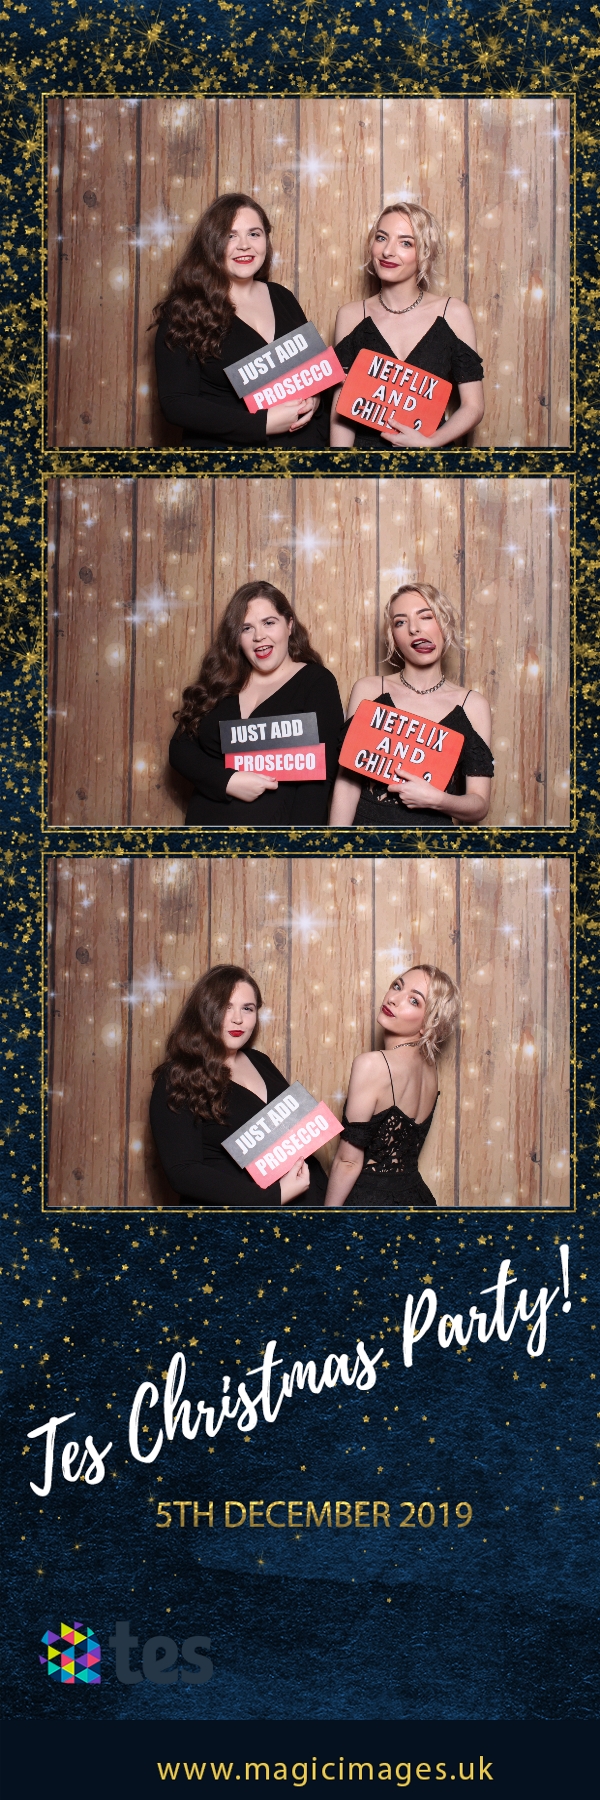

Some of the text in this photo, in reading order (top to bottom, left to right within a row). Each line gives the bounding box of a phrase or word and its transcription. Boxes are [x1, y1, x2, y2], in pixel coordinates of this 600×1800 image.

[238, 333, 308, 385] JUST ADD
[368, 355, 439, 399] NETFLIX
[253, 359, 333, 409] PROSECCO
[372, 385, 417, 412] AND
[230, 719, 303, 744] JUST ADD
[370, 706, 448, 751] NETFLIX
[376, 737, 425, 764] AND
[234, 753, 315, 772] PROSECCO
[235, 1094, 299, 1155] JUST ADD
[255, 1114, 329, 1176] PROSECCO
